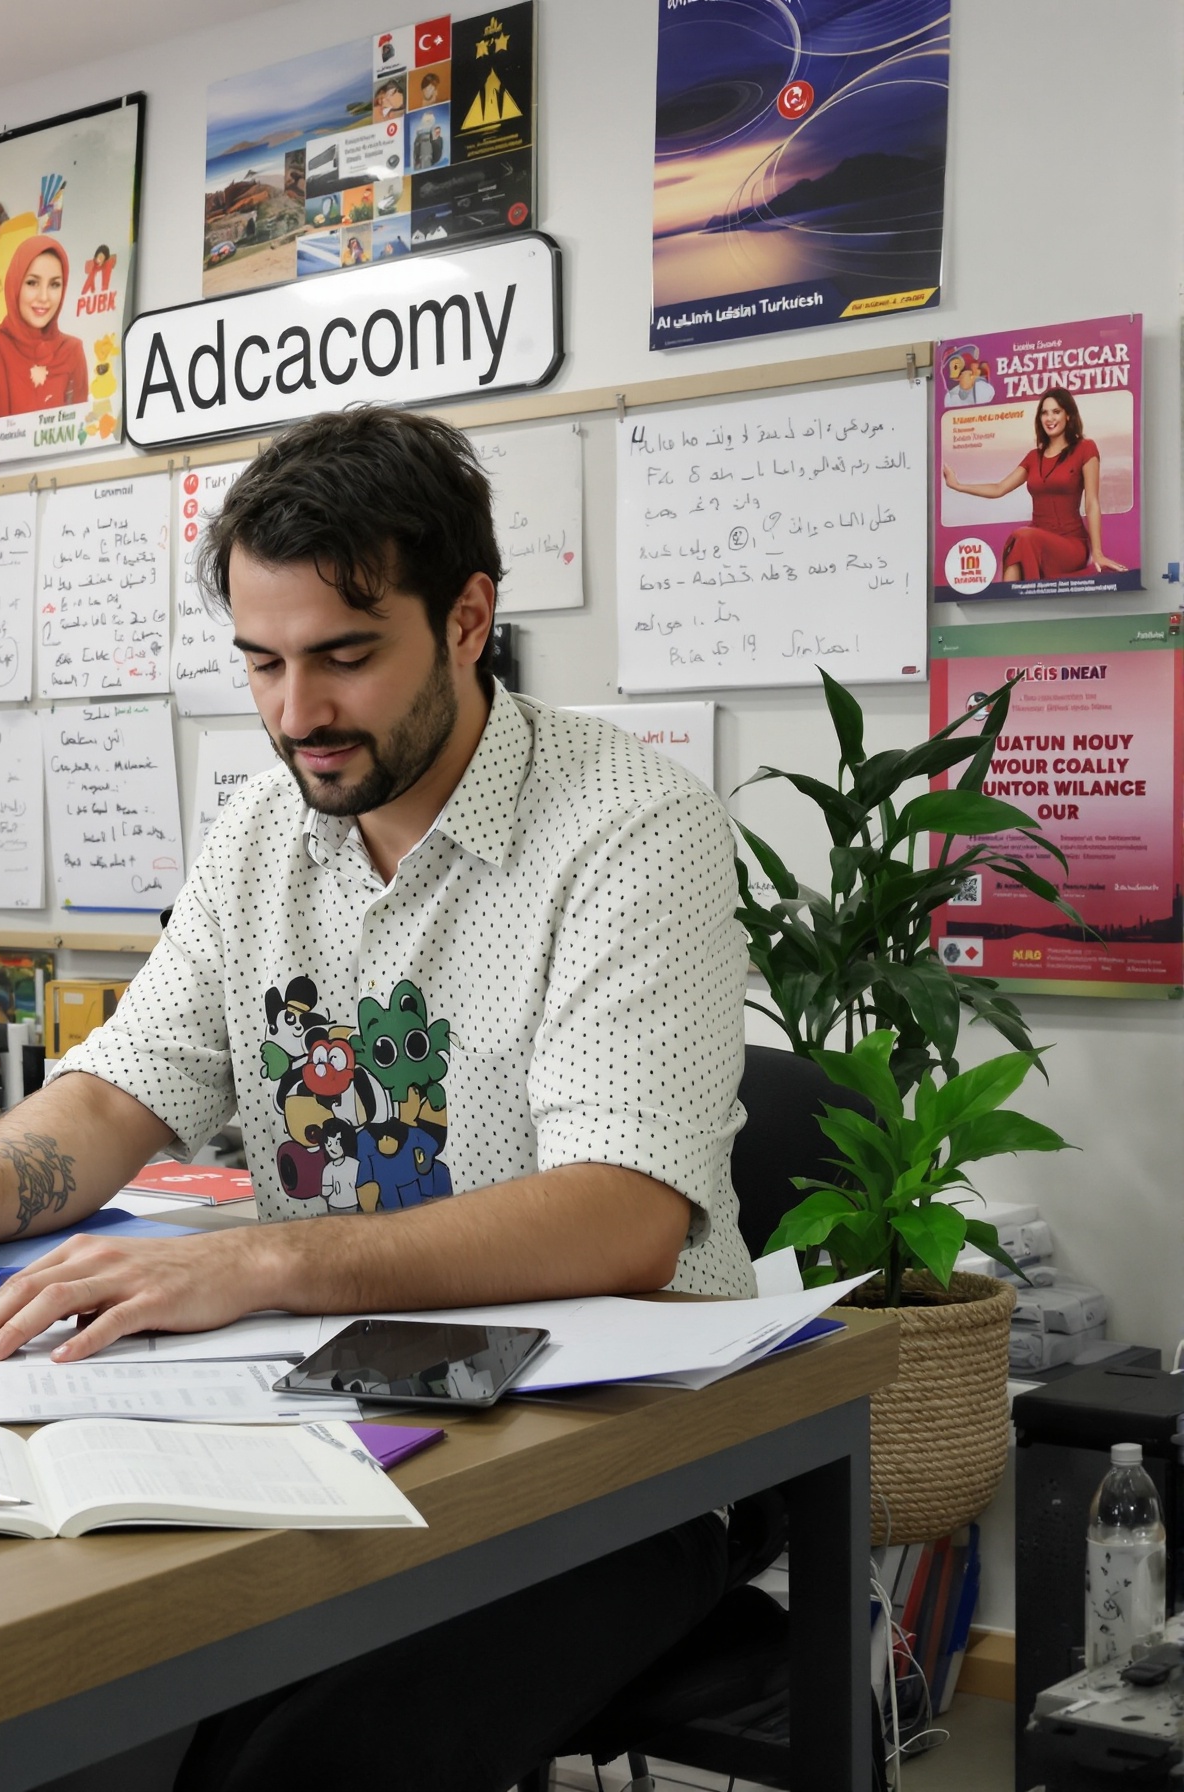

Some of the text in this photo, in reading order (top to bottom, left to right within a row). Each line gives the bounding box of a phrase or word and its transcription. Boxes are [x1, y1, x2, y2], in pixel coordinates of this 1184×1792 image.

[135, 283, 518, 420] Adcacomy
[214, 771, 249, 786] Learn
[1054, 780, 1147, 796] WILANCE
[1037, 804, 1079, 820] OUR
